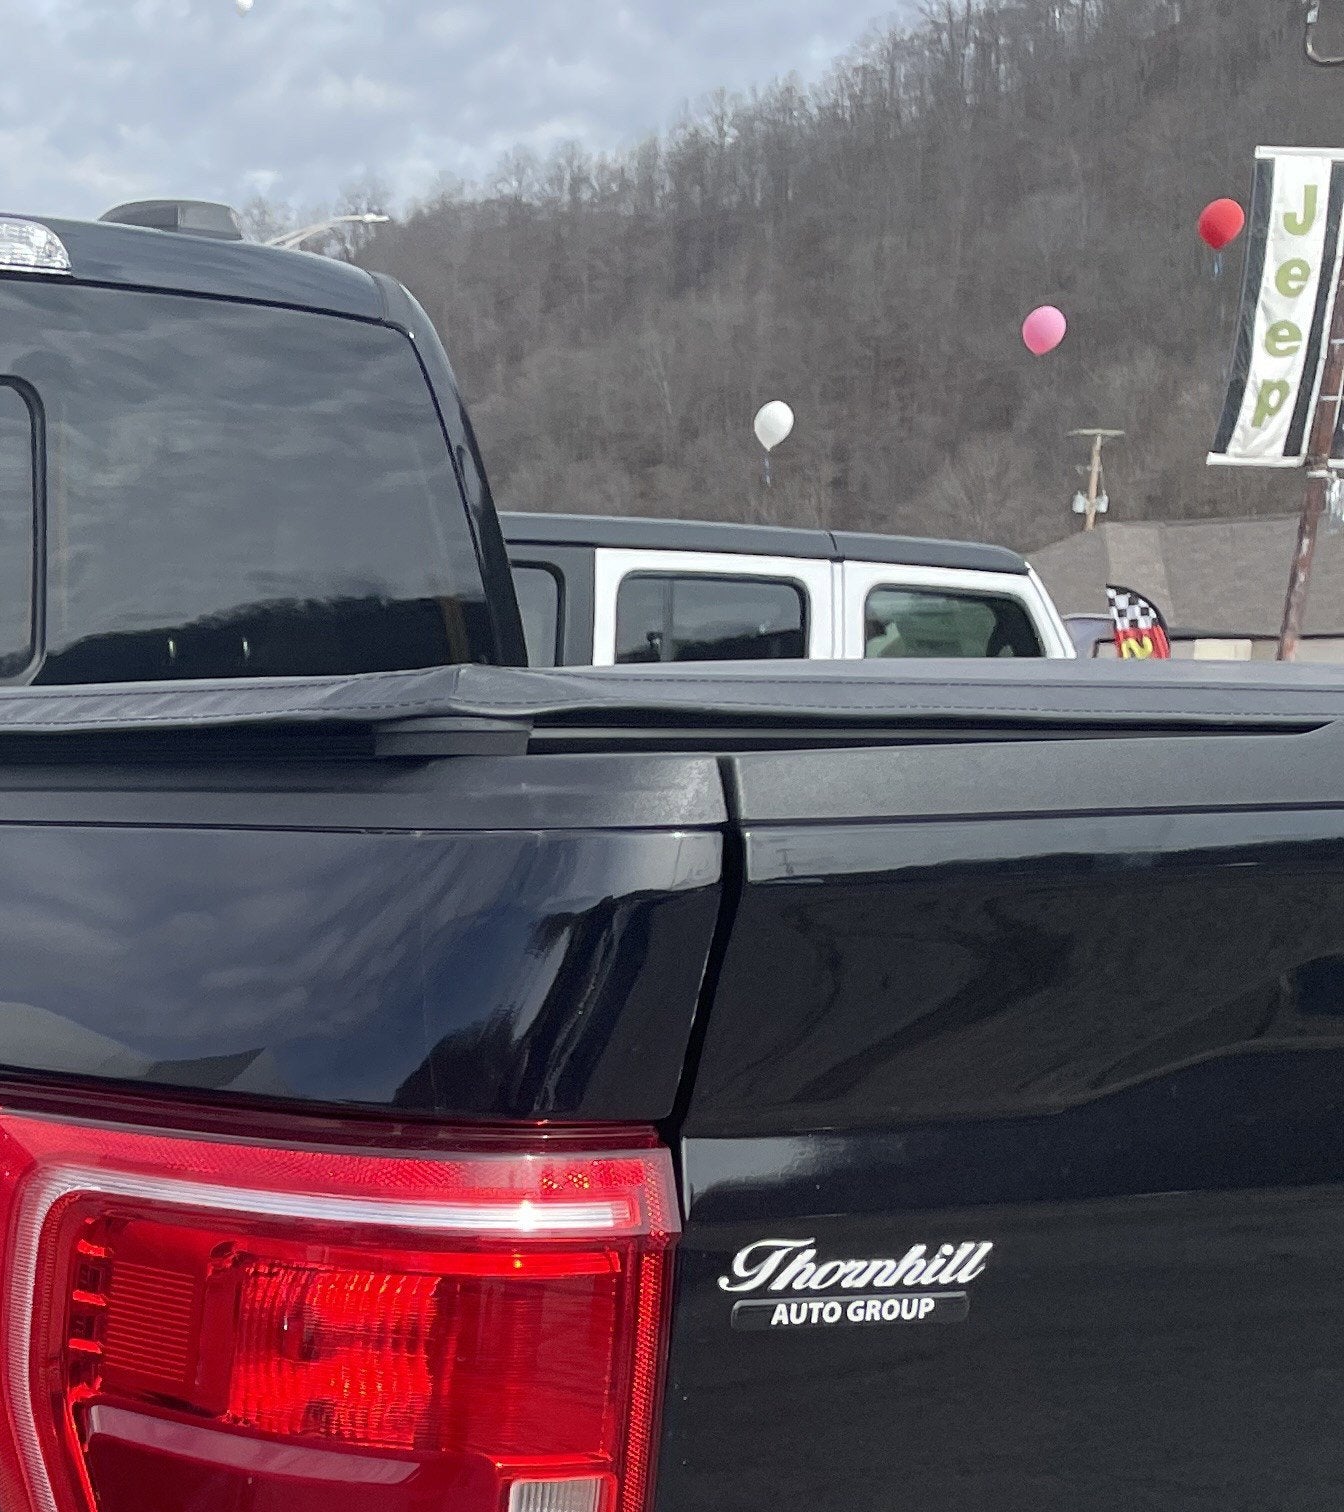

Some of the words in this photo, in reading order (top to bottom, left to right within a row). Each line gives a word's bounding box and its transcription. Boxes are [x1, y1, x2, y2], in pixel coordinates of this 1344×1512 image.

[1251, 184, 1318, 427] Jeep
[718, 1237, 994, 1293] Thornhill
[771, 1300, 841, 1326] AUTO
[846, 1297, 935, 1323] GROUP
